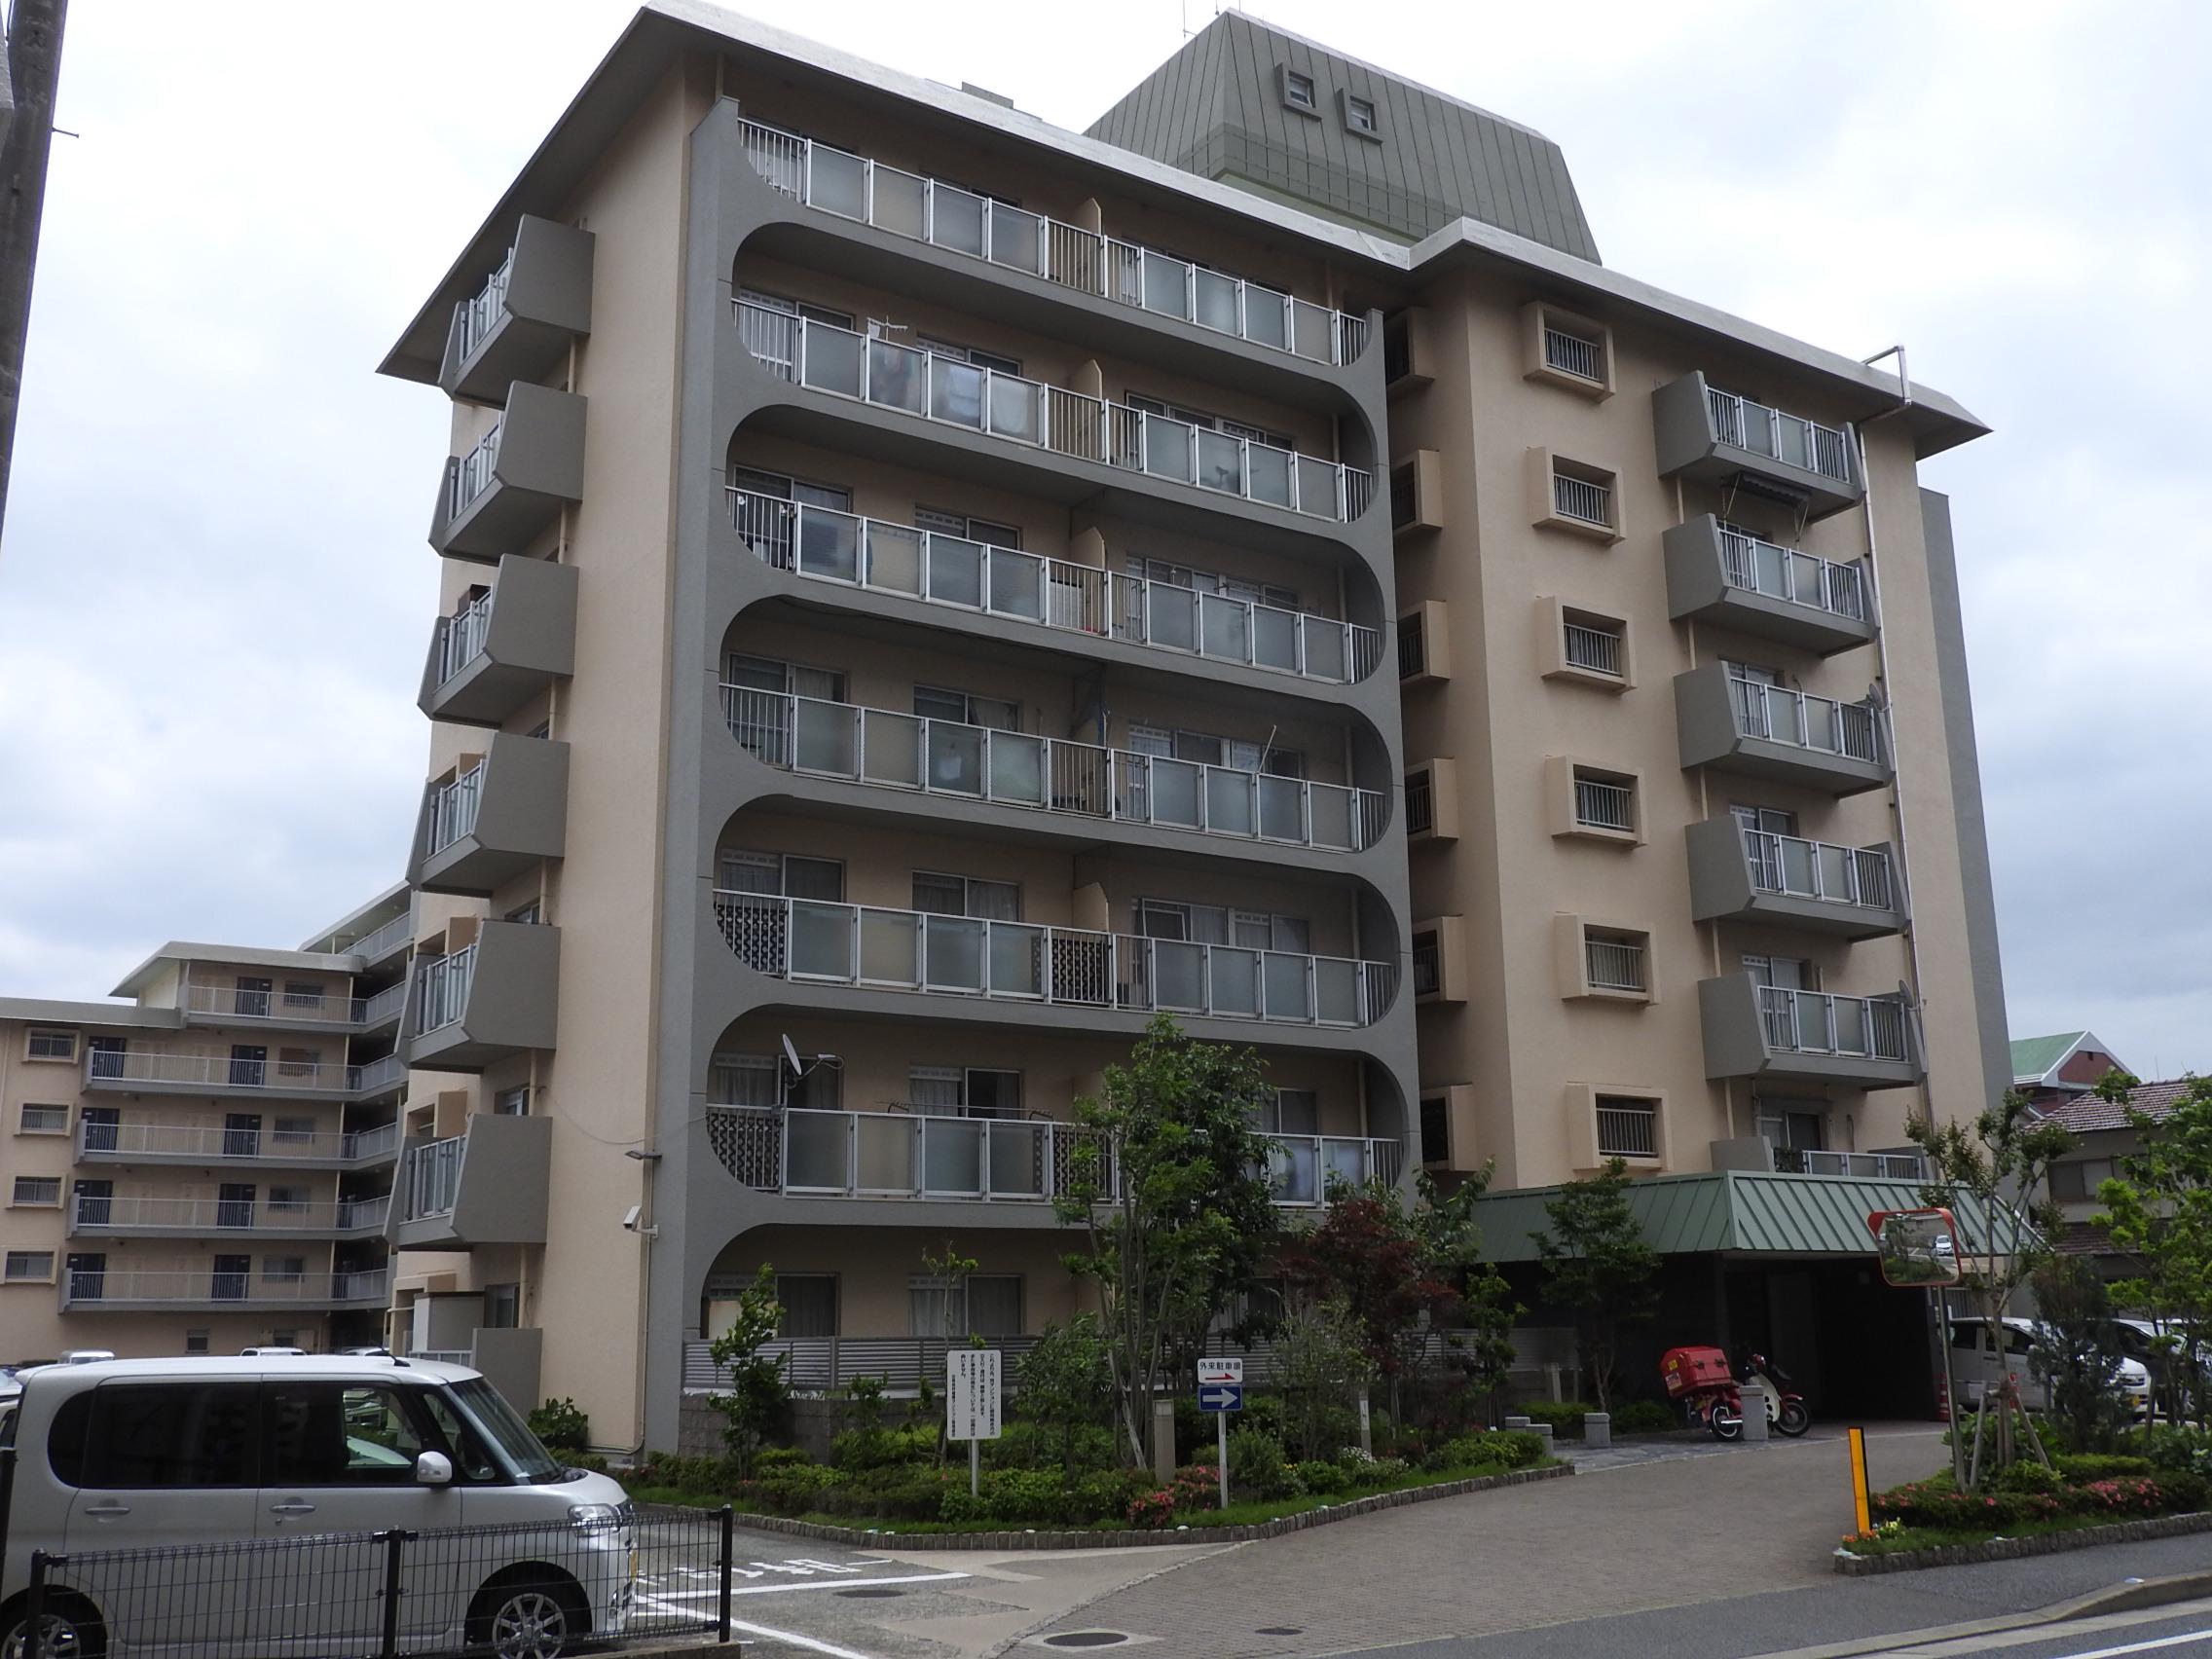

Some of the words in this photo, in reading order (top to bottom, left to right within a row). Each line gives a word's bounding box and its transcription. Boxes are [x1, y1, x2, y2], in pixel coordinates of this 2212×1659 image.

[1199, 1361, 1241, 1371] 外来駐車場
